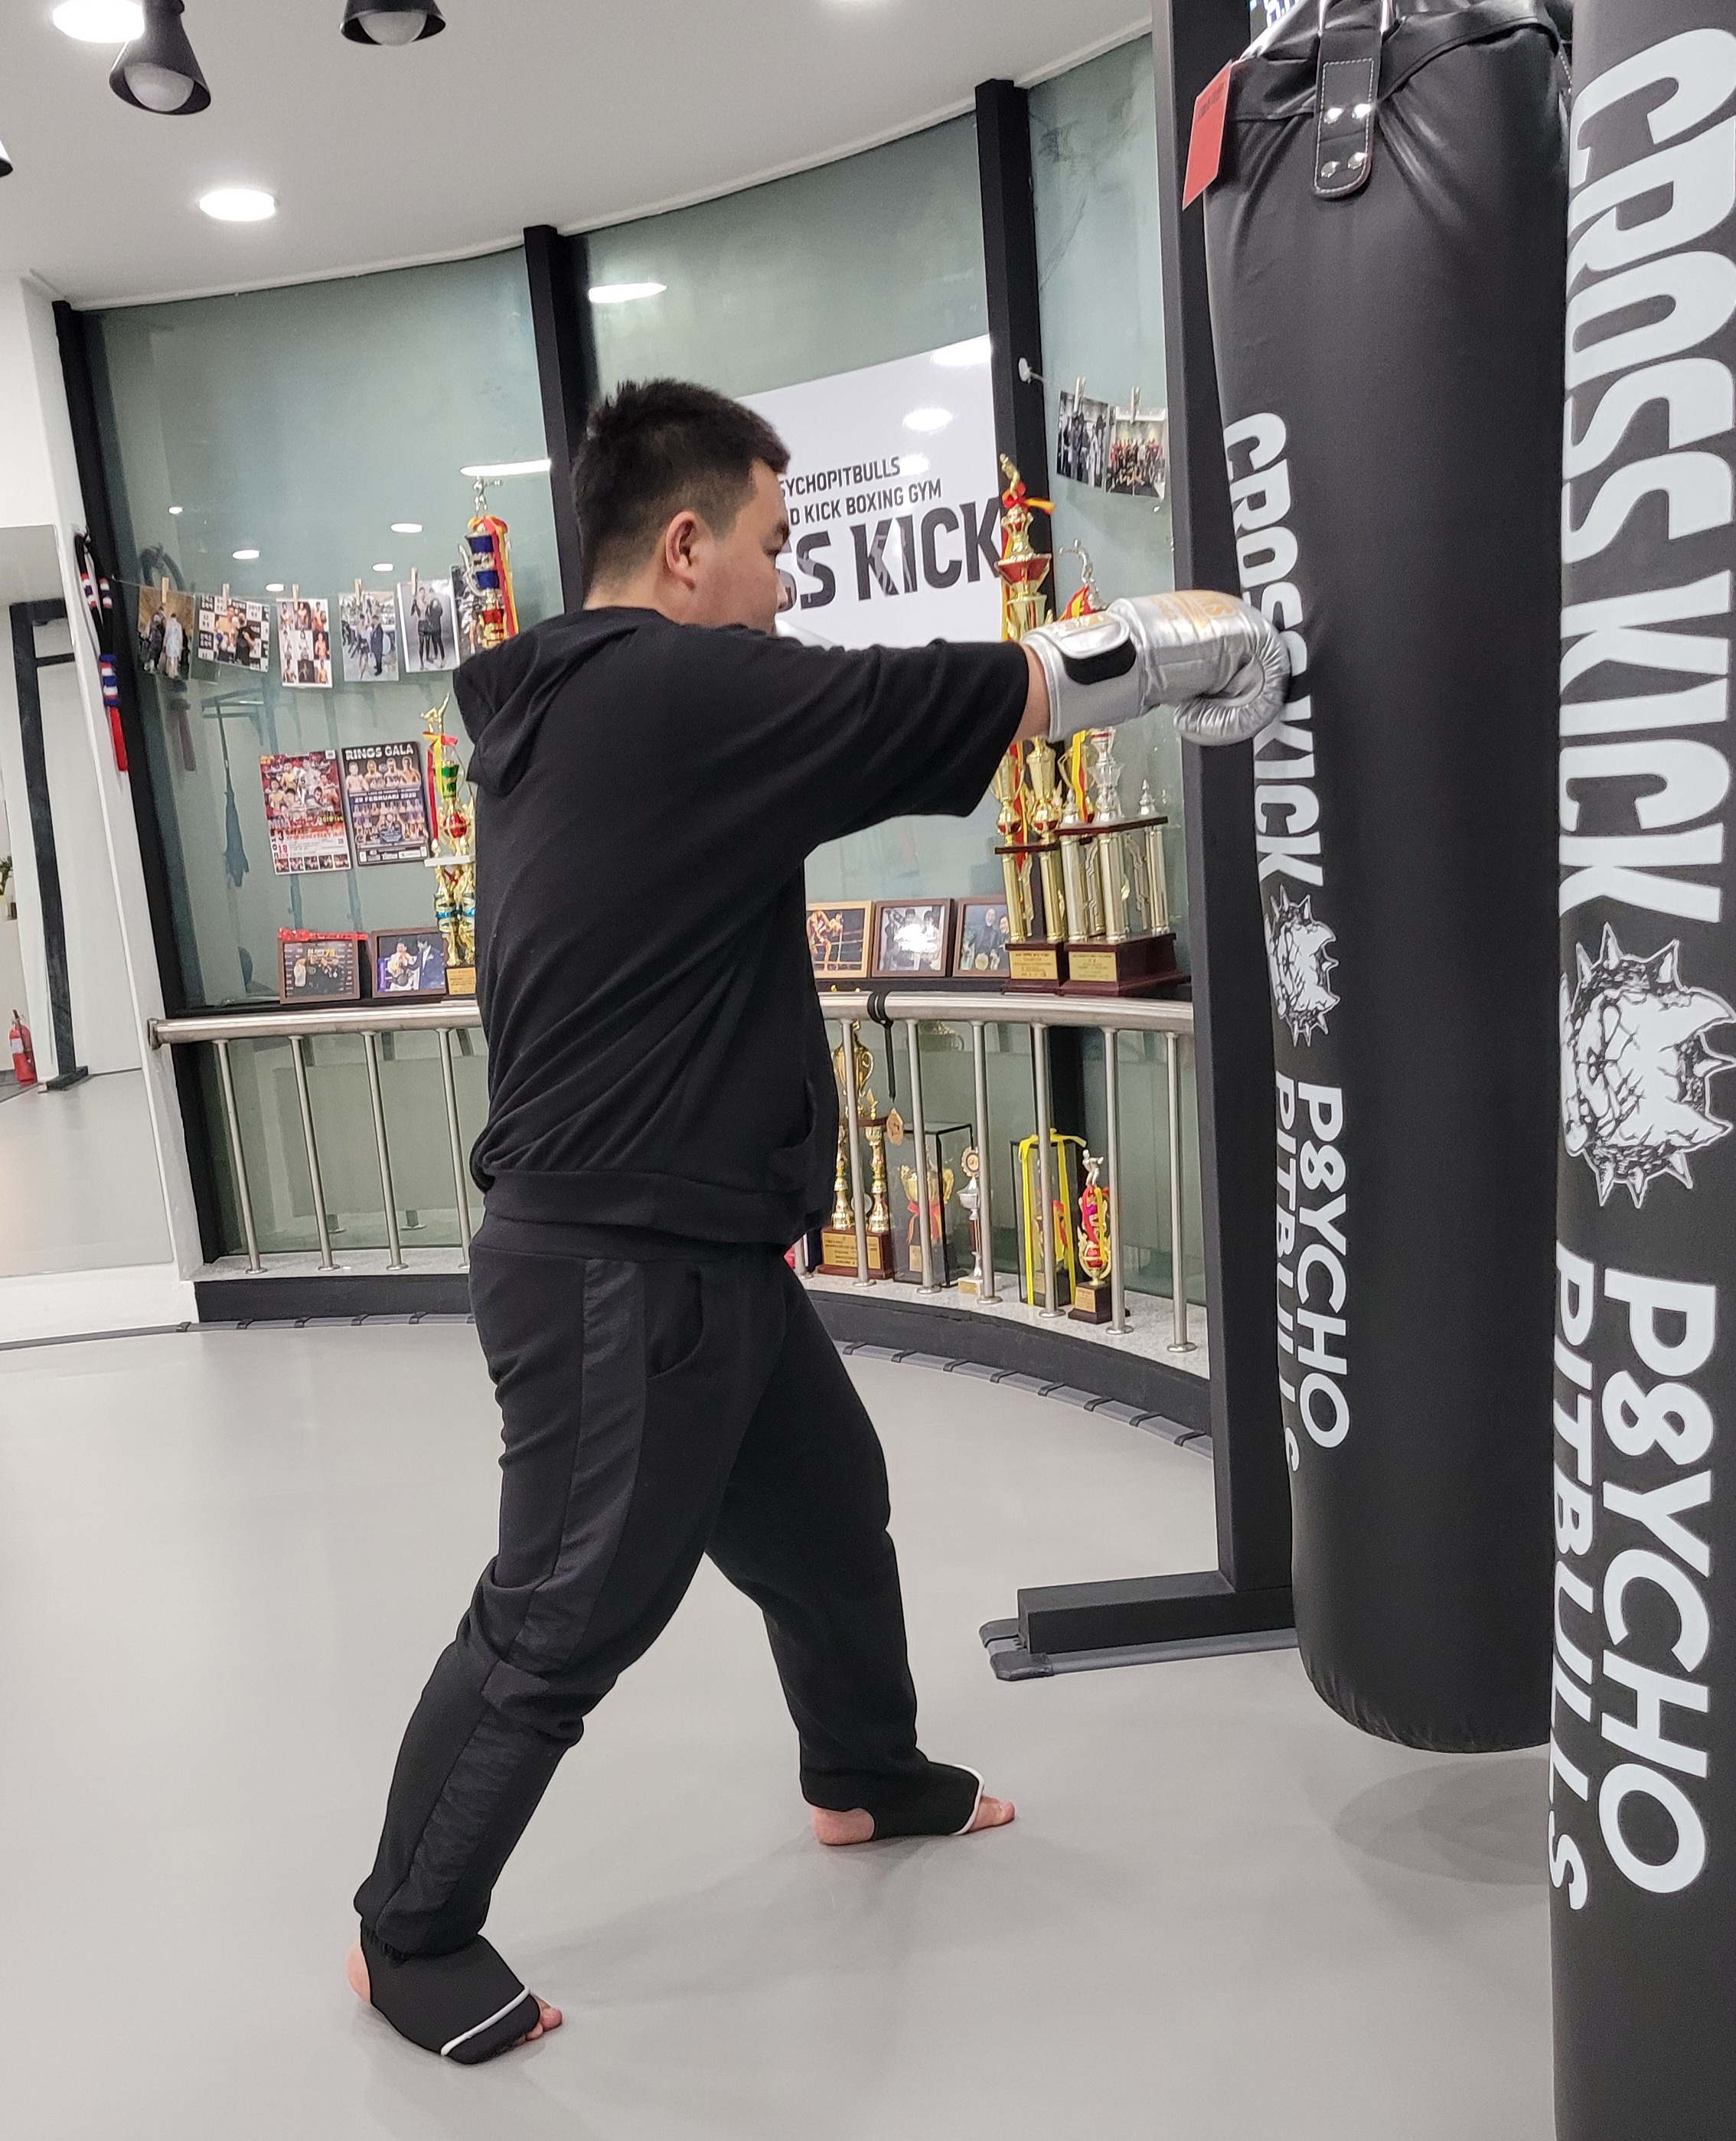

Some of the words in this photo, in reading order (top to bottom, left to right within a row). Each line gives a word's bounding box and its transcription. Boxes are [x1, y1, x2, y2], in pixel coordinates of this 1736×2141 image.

[1562, 28, 1736, 564] CROSS
[804, 499, 842, 524] KICK
[846, 487, 904, 515] BOXING
[909, 478, 941, 504] GYM
[850, 498, 1003, 602] KICK
[345, 747, 382, 760] RINGS
[385, 744, 414, 756] GALA
[1253, 695, 1323, 887] KICK
[1558, 570, 1731, 923] KICK
